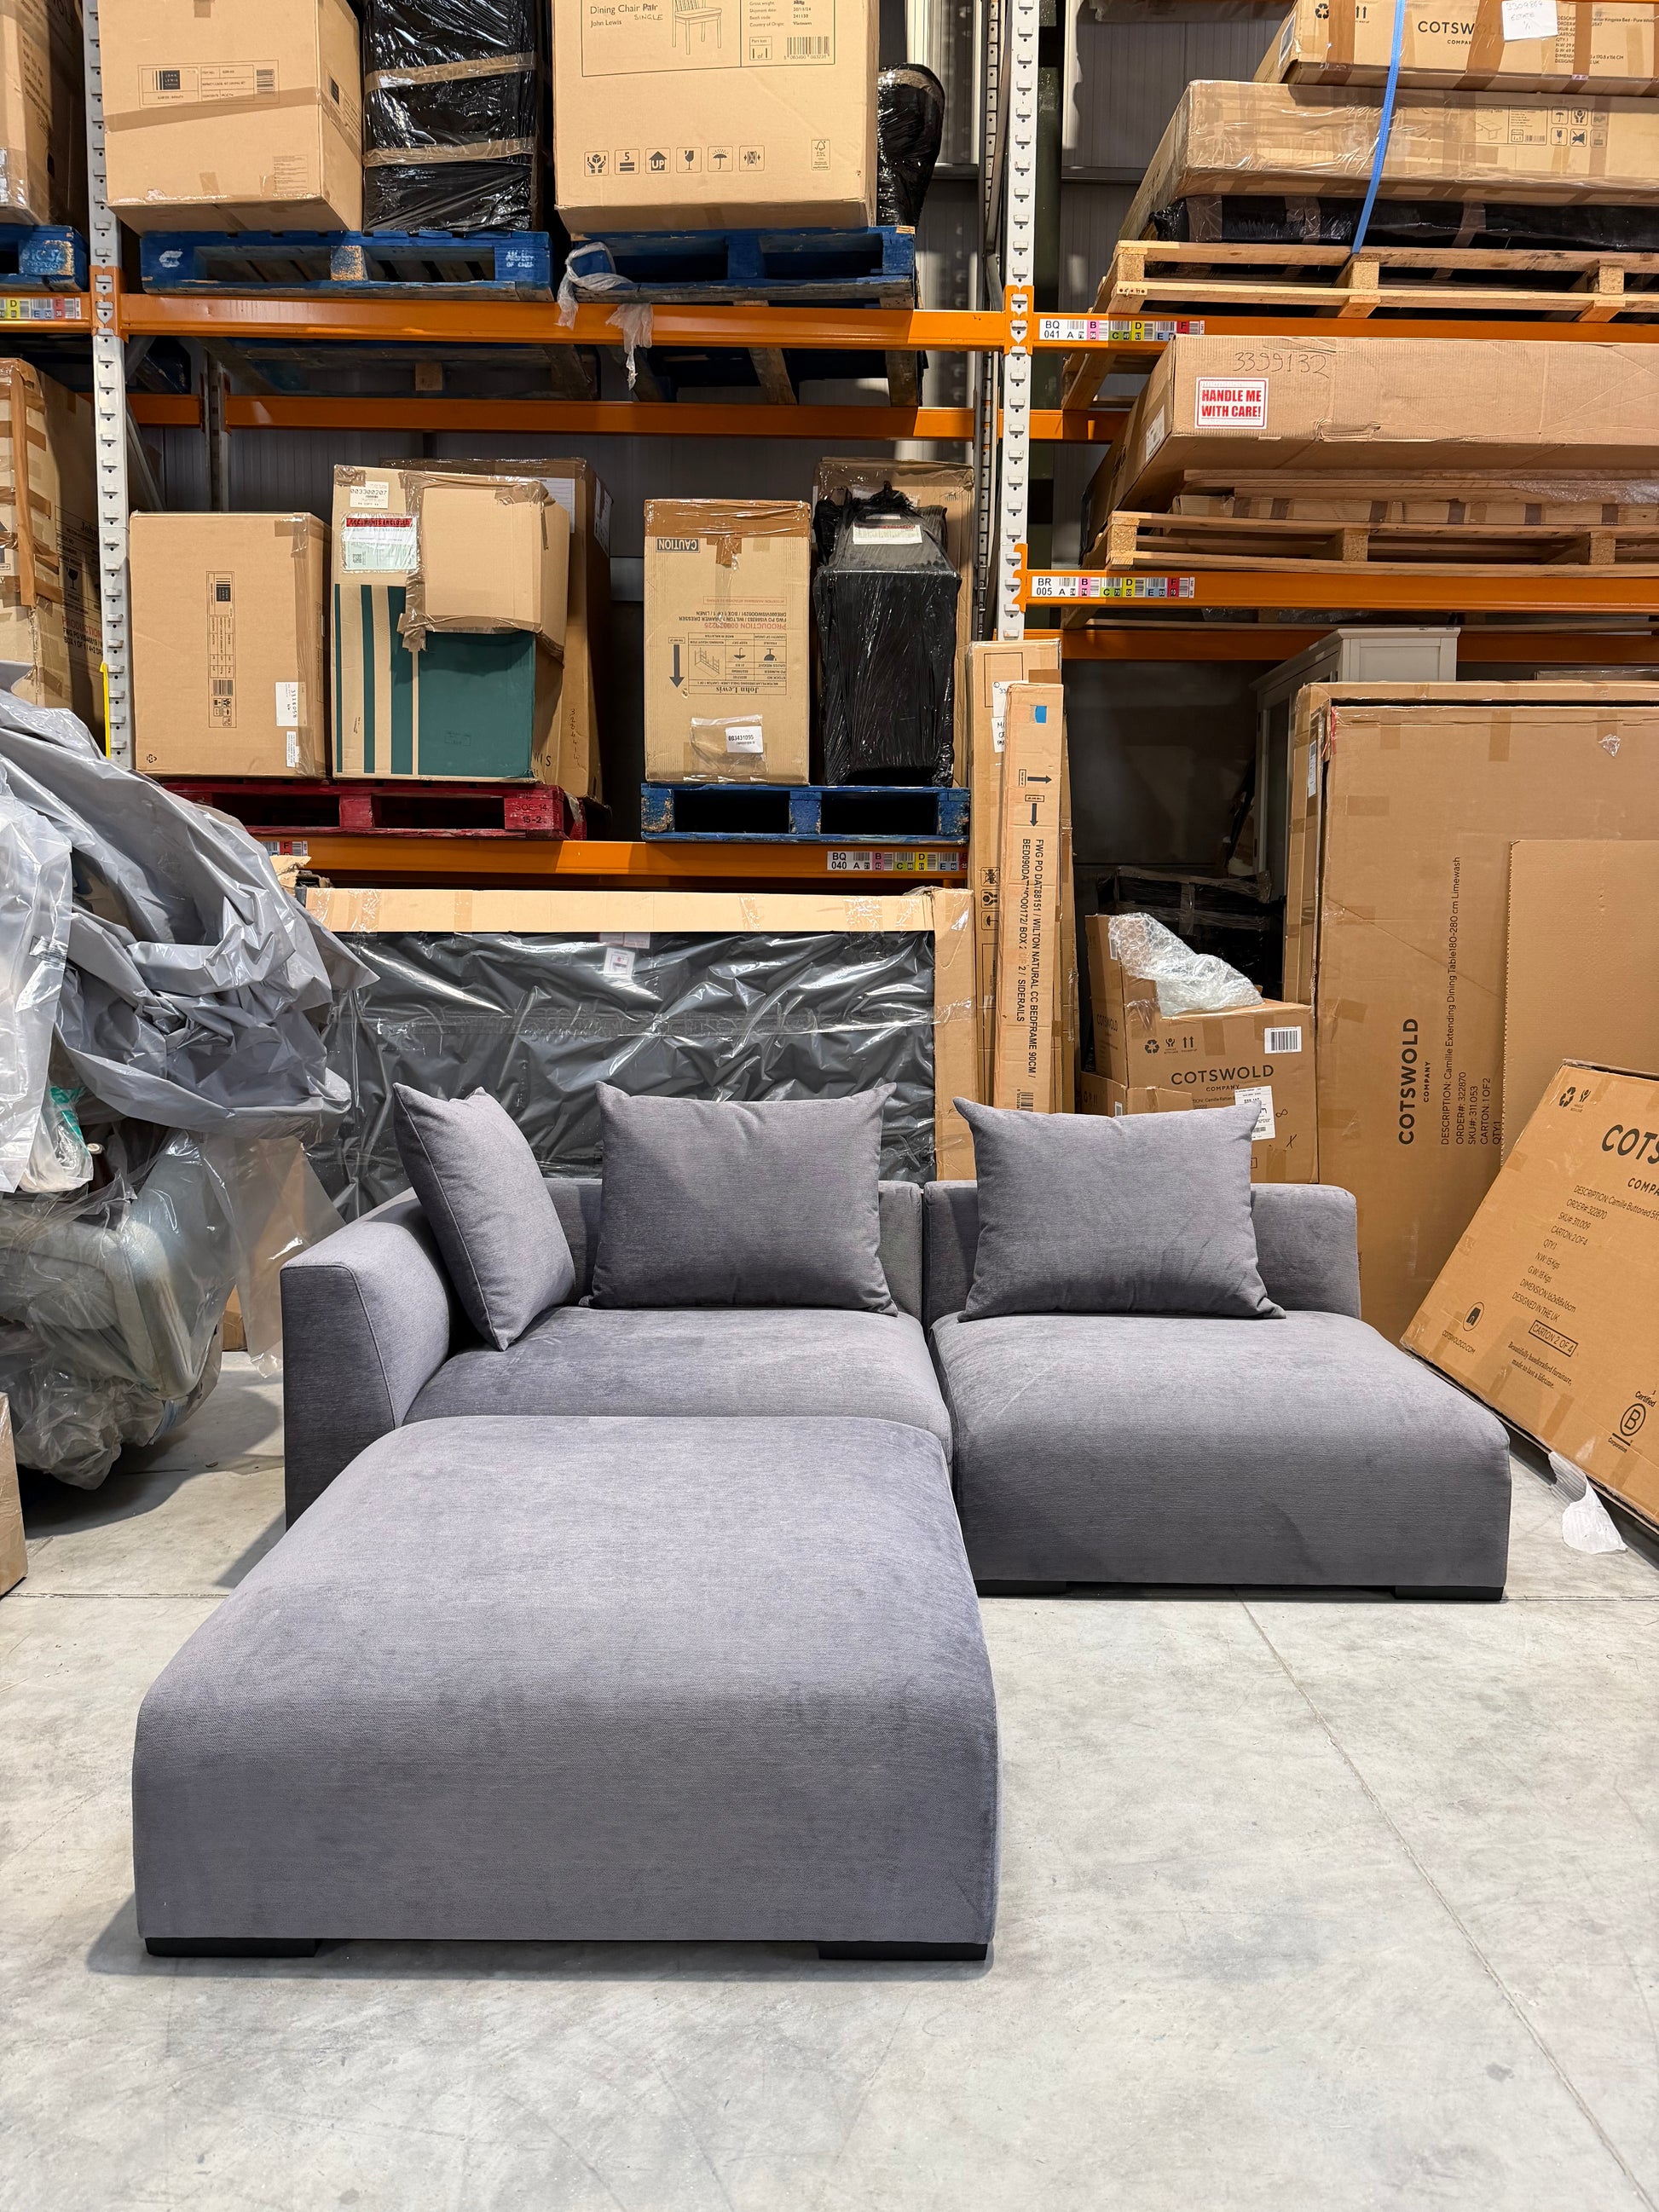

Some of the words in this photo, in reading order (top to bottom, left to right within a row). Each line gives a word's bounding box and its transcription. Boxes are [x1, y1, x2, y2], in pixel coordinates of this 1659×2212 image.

[590, 6, 616, 15] Dining
[642, 3, 658, 12] Pair
[1418, 20, 1476, 35] COTSW
[624, 152, 630, 161] 5
[651, 160, 665, 170] UP
[1044, 330, 1060, 339] 041
[1046, 321, 1060, 329] BQ
[1233, 352, 1329, 378] 3399132
[1202, 390, 1243, 402] HANDLE
[1246, 390, 1261, 402] ME
[1202, 406, 1229, 417] WITH
[1232, 406, 1261, 417] CARE!
[658, 539, 697, 550] CAUTION
[1035, 839, 1044, 858] FWG
[1035, 860, 1043, 871] PO
[1451, 857, 1460, 899] Limewash
[1033, 874, 1042, 911] DAT88151
[1452, 901, 1458, 914] cm
[1032, 919, 1041, 949] WILTON
[1448, 916, 1458, 973] Table180-280
[1031, 952, 1040, 989] NATURAL
[1017, 979, 1026, 1022] SIDERAILS
[1031, 992, 1039, 1003] CC
[1447, 975, 1457, 1002] Dining
[1029, 1006, 1038, 1050] BEDFRAME
[1446, 1004, 1456, 1046] Extending
[1028, 1052, 1036, 1073] 90CM
[1171, 1064, 1274, 1085] COTSWOLD
[1444, 1049, 1453, 1079] Camille
[1399, 1019, 1418, 1145] COTSWOLD
[1441, 1082, 1451, 1145] DESCRIPTION:
[1469, 1086, 1478, 1116] 311.053
[1456, 1104, 1465, 1145] ORDER#:
[1468, 1118, 1477, 1145] SKU#:
[1480, 1104, 1489, 1145] CARTON:
[1573, 1185, 1608, 1202] DESCRIPTION:
[1608, 1196, 1627, 1209] Camille
[1627, 1202, 1651, 1217] Buttoned
[1512, 1292, 1536, 1309] DESIGNED
[1540, 1307, 1552, 1318] THE
[1550, 1312, 1560, 1322] UK
[1532, 1324, 1554, 1343] CARTON
[1554, 1336, 1559, 1345] 2
[1559, 1339, 1569, 1350] OF
[1568, 1344, 1573, 1353] 4
[1508, 1341, 1528, 1359] Beautifully
[1528, 1352, 1552, 1373] handcrafted
[1552, 1366, 1571, 1386] furniture,
[1512, 1359, 1522, 1369] made
[1527, 1366, 1535, 1377] last
[1537, 1372, 1554, 1389] lifetime.
[1635, 1391, 1657, 1407] Certified
[1624, 1409, 1640, 1431] B
[1608, 1438, 1627, 1453] Corporation
